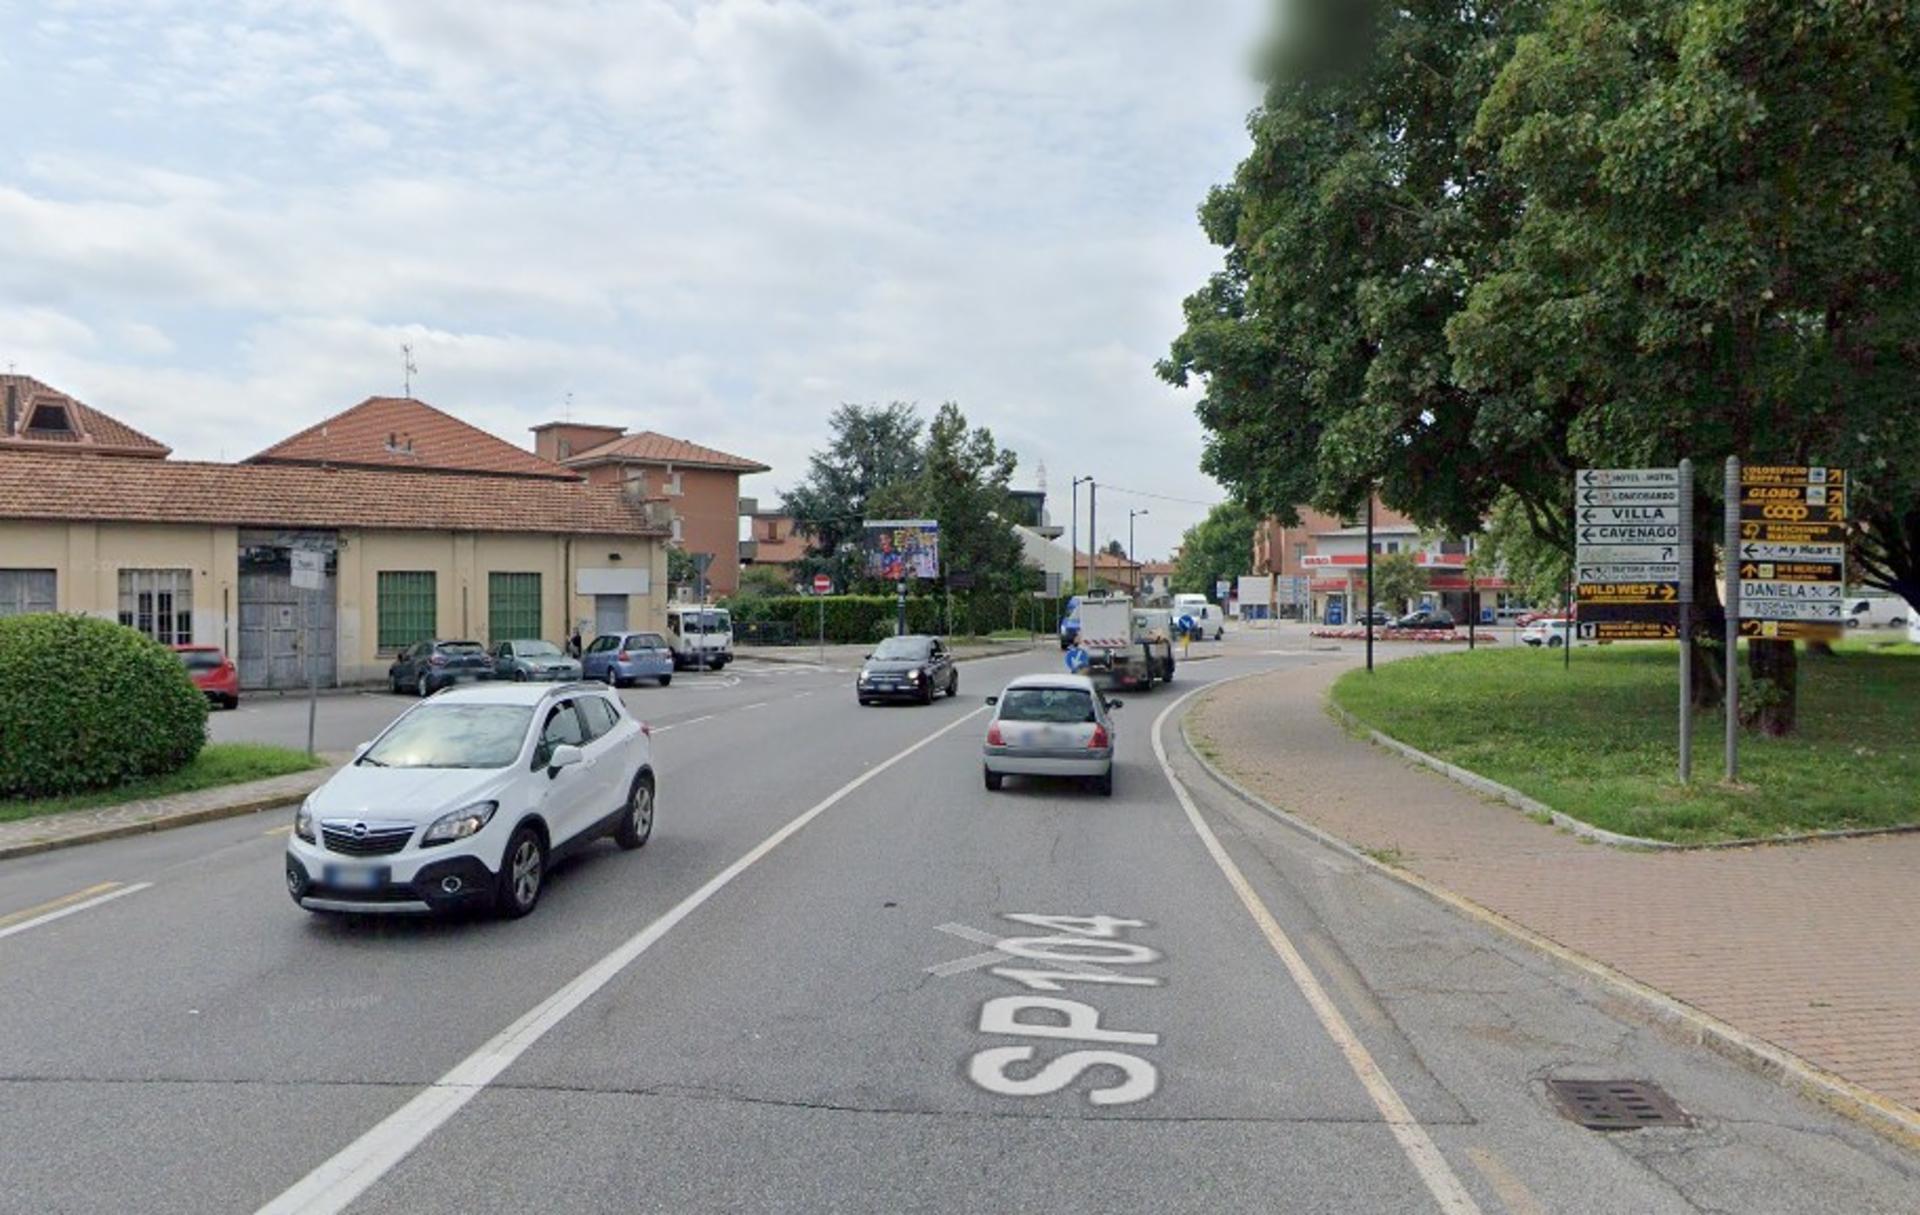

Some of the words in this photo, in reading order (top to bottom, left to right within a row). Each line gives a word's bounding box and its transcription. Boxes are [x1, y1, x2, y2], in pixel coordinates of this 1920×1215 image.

[1749, 487, 1800, 498] GLOBO
[1611, 508, 1666, 519] VILLA
[1600, 527, 1678, 538] CAVENAGO
[1777, 545, 1796, 555] My
[1799, 545, 1833, 554] Heart
[1579, 584, 1616, 595] WILD
[1617, 584, 1658, 595] WEST
[1744, 583, 1808, 597] DANIELA
